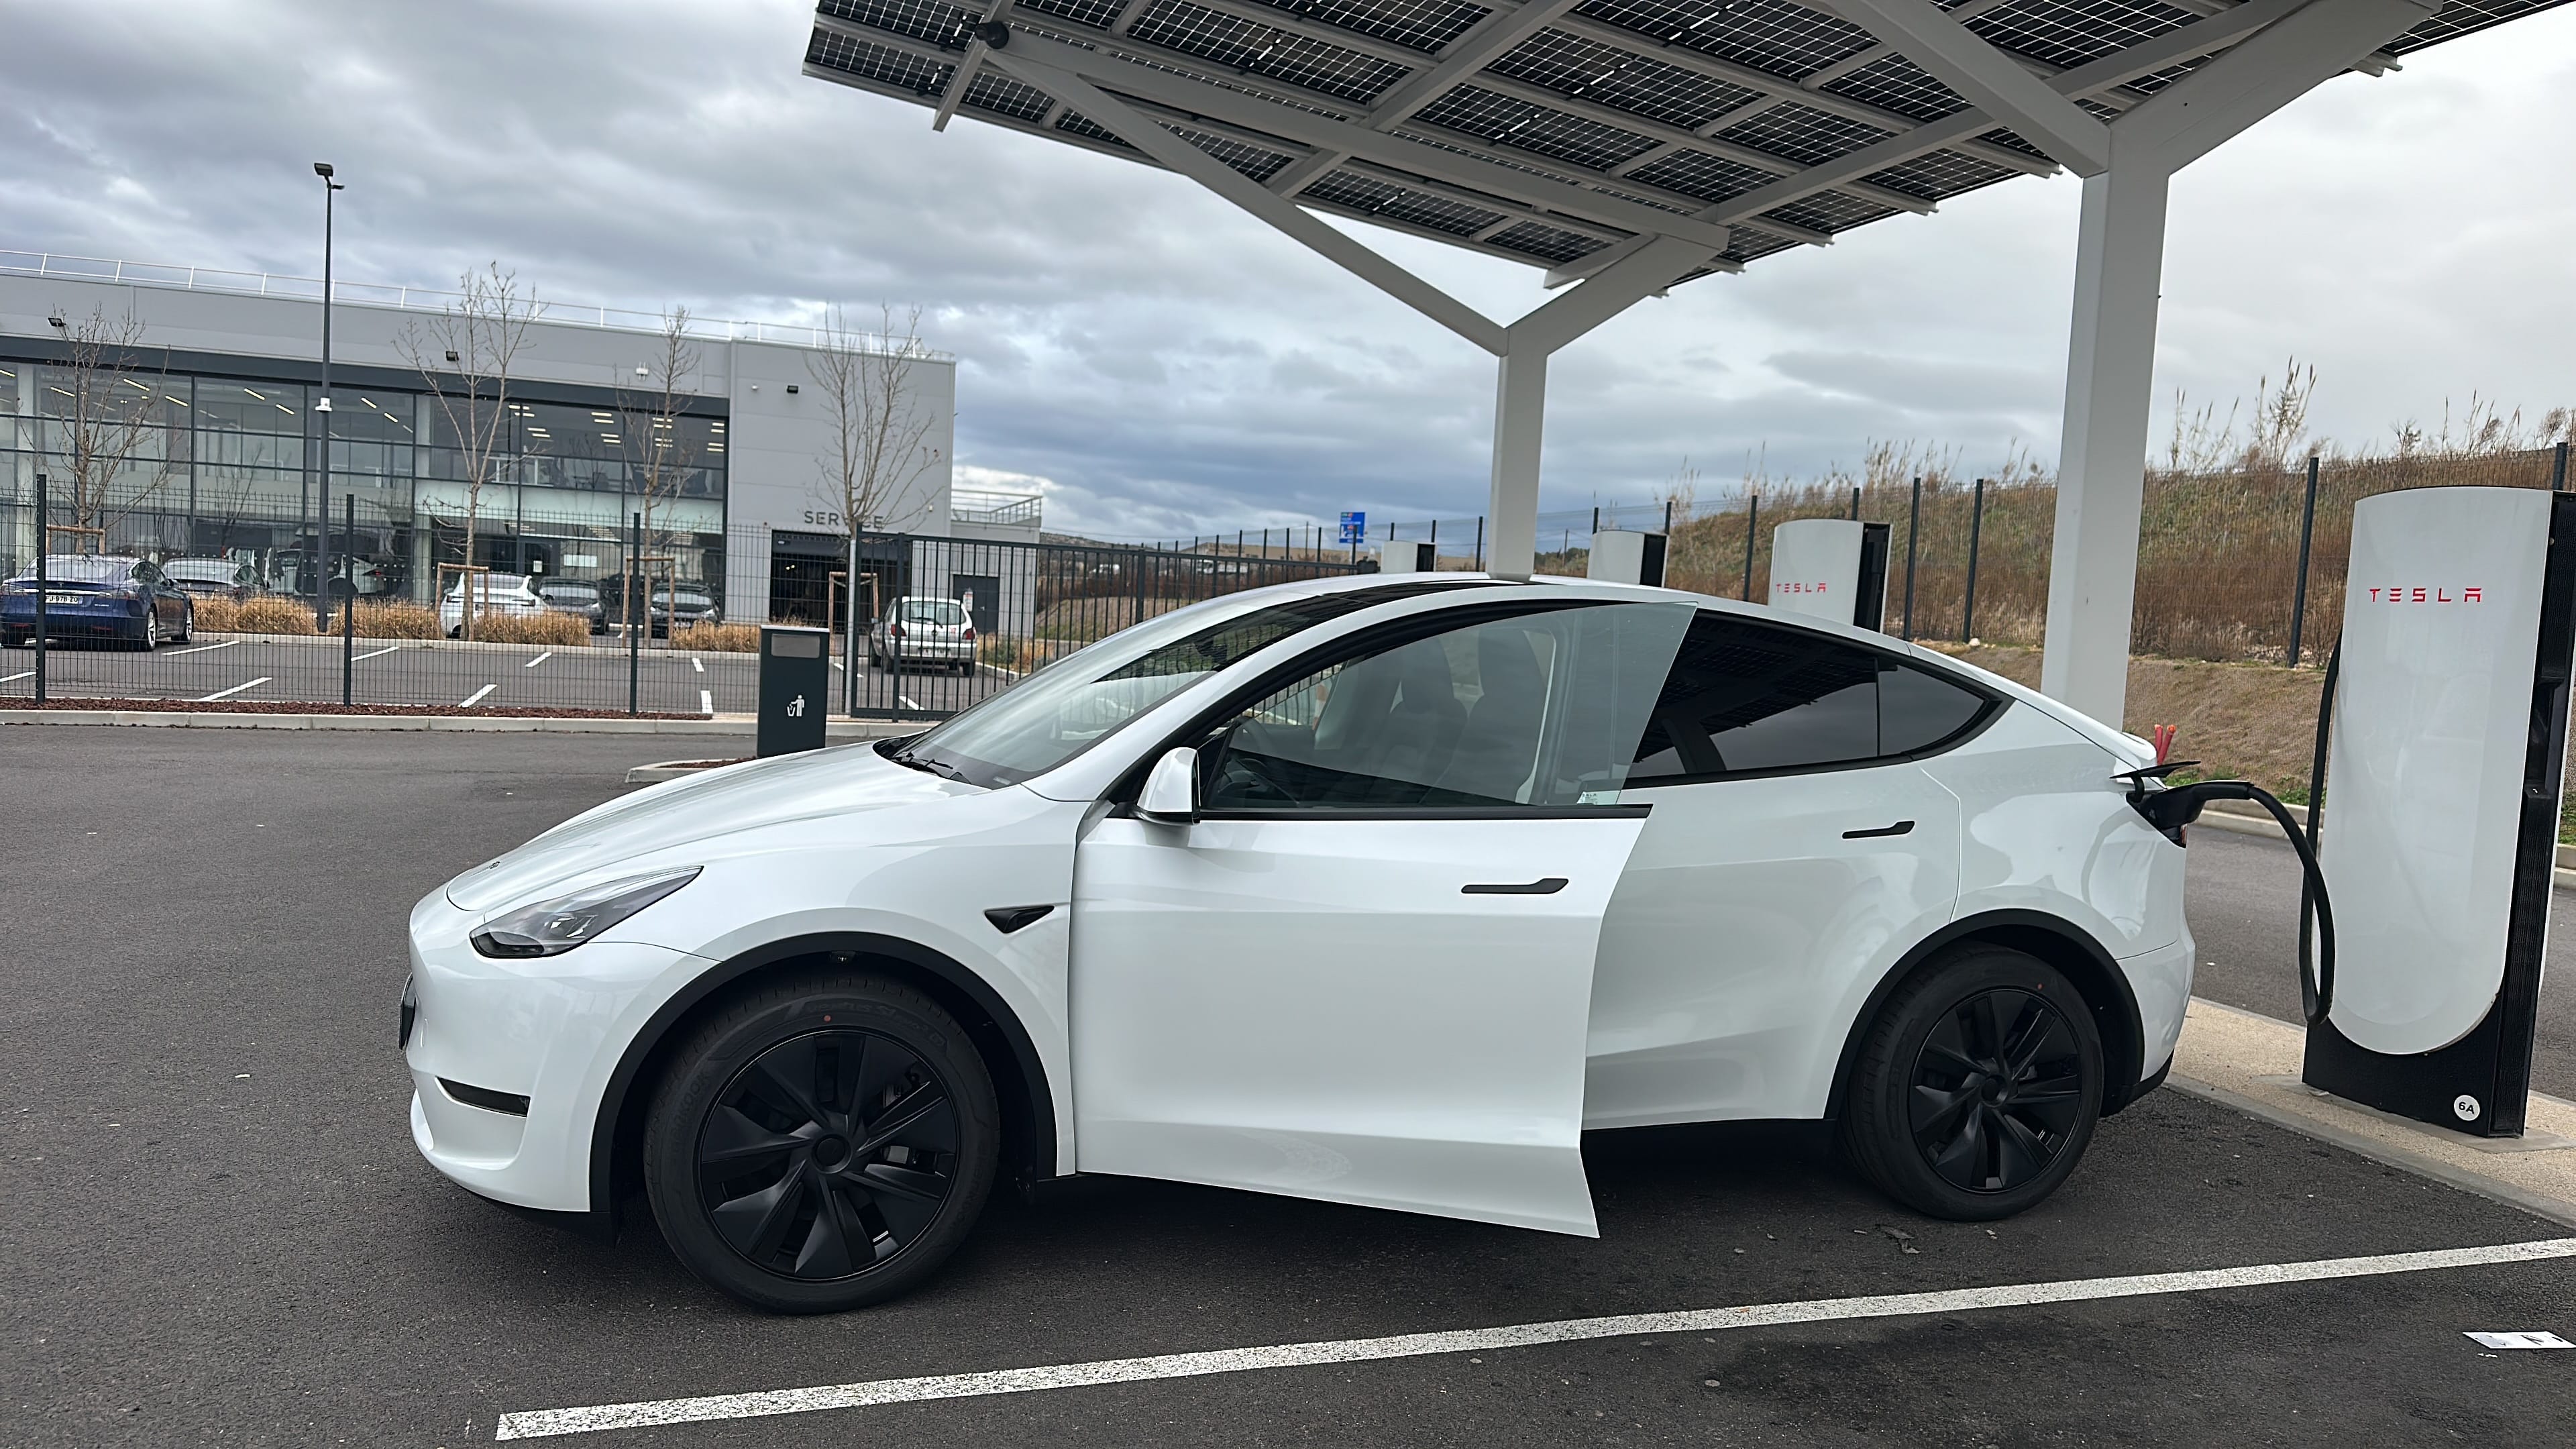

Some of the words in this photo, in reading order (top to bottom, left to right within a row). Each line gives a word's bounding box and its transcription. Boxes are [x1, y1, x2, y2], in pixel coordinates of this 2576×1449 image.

[804, 511, 883, 529] SERCE
[1776, 582, 1826, 593] TESLA
[2369, 588, 2482, 602] TESLA
[2459, 1102, 2475, 1114] 6A
